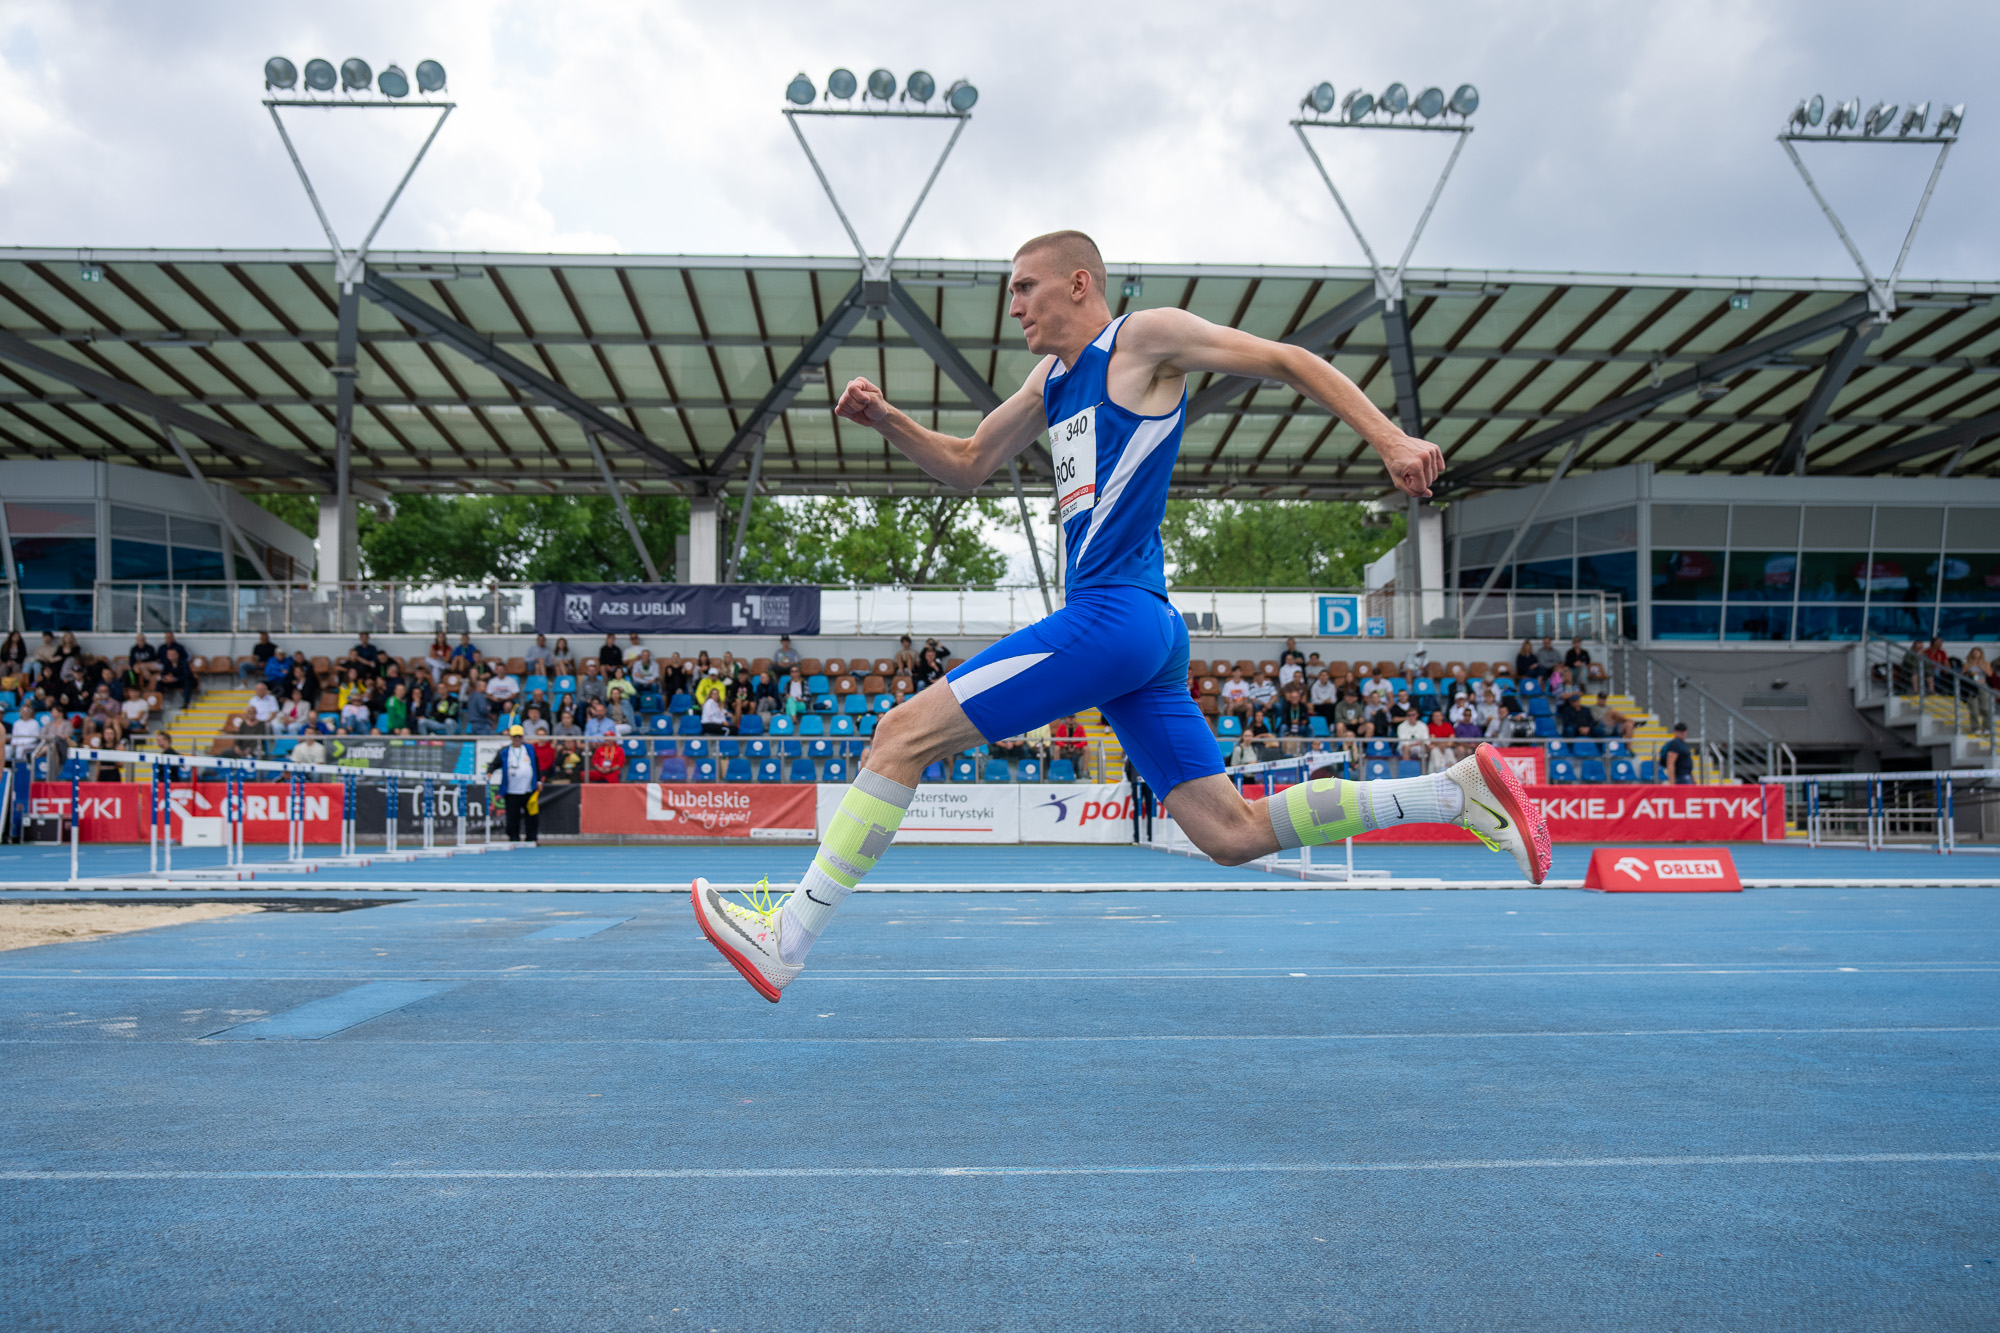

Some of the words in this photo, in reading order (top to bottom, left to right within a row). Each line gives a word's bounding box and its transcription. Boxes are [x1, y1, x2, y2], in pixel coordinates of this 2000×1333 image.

[1066, 415, 1088, 442] 340
[1056, 456, 1076, 488] RÓG
[599, 602, 630, 615] AZS
[632, 602, 686, 615] LUBLIN
[1327, 606, 1351, 633] D
[32, 797, 121, 819] ETYKI
[220, 795, 329, 821] ORLEN
[667, 789, 750, 809] lubelskie
[912, 792, 968, 803] sterstwo
[931, 807, 936, 818] i
[939, 807, 994, 820] Turystyki
[1661, 864, 1717, 875] ORLEN
